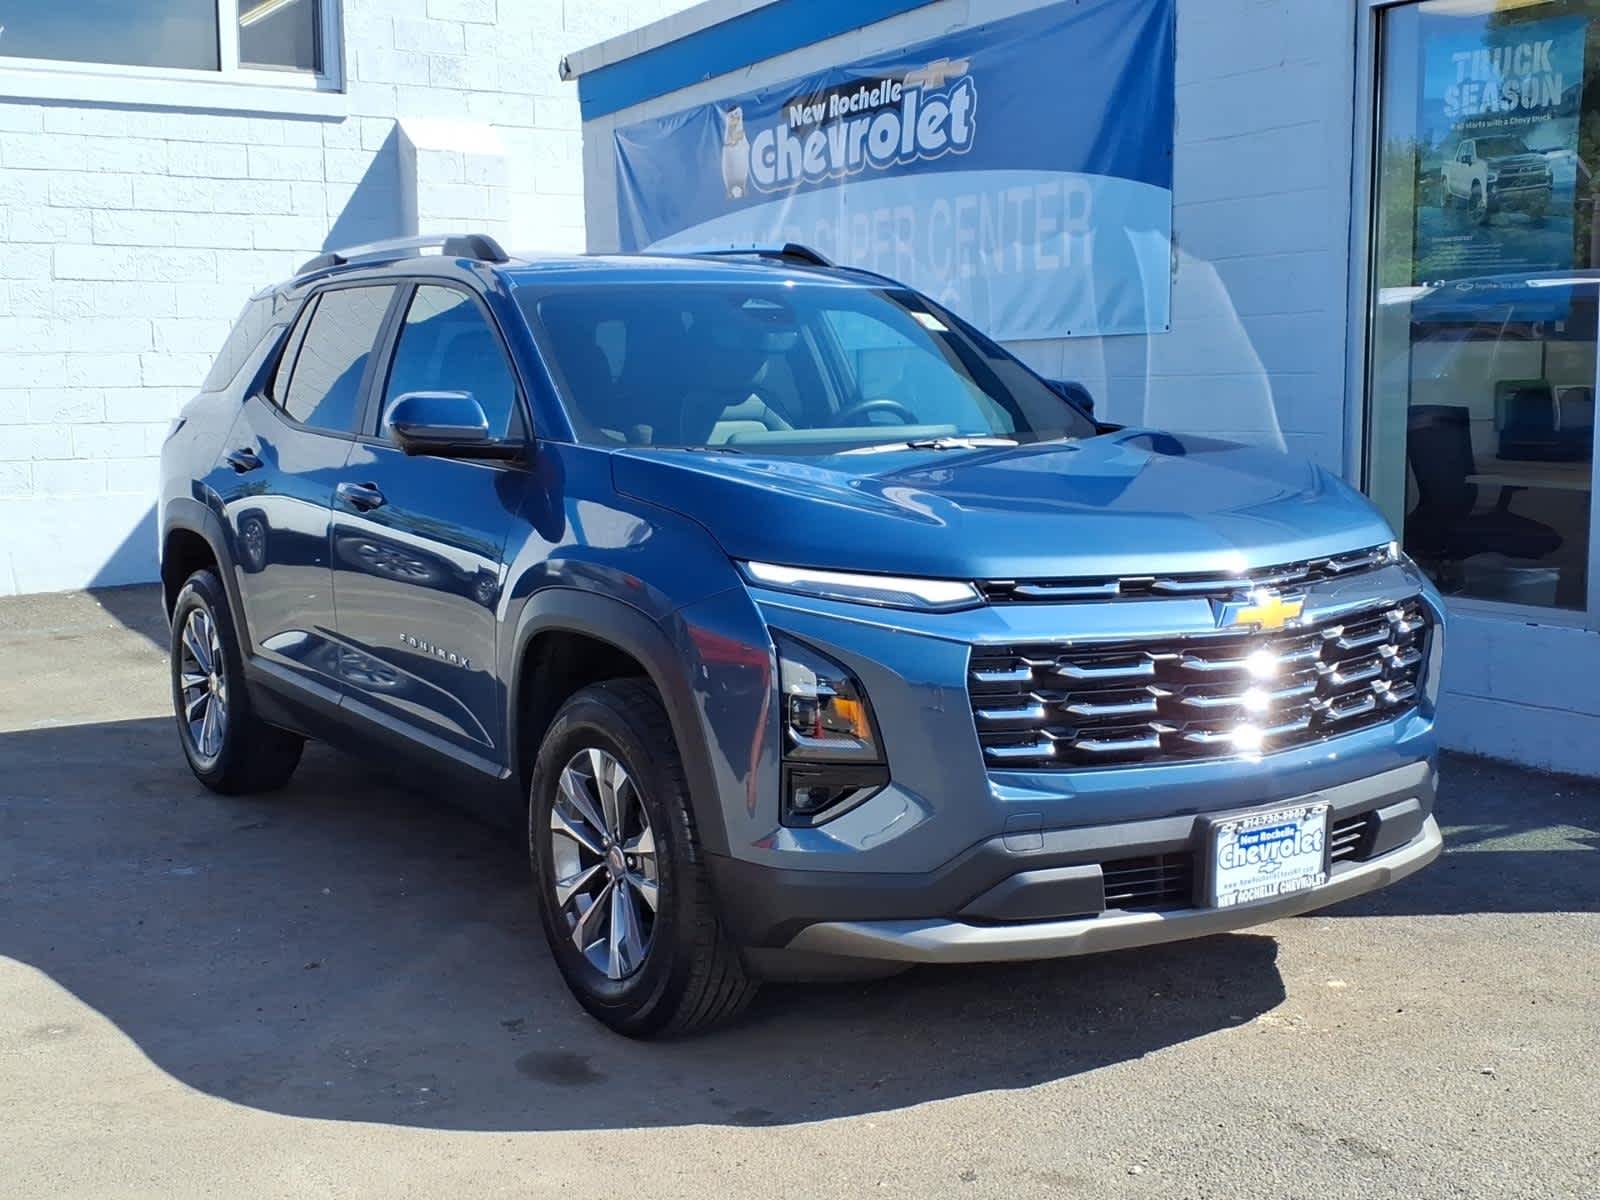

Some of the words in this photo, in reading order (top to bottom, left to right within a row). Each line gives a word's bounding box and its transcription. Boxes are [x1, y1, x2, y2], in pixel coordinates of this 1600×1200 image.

[1451, 40, 1554, 84] TRUCK
[789, 101, 827, 129] New
[829, 79, 902, 118] Rochelle
[1443, 72, 1563, 117] SEASON
[750, 81, 973, 187] Chevrolet
[927, 178, 1094, 282] CENTER
[399, 632, 472, 670] EQUINOX
[1219, 828, 1322, 870] Chevrolet
